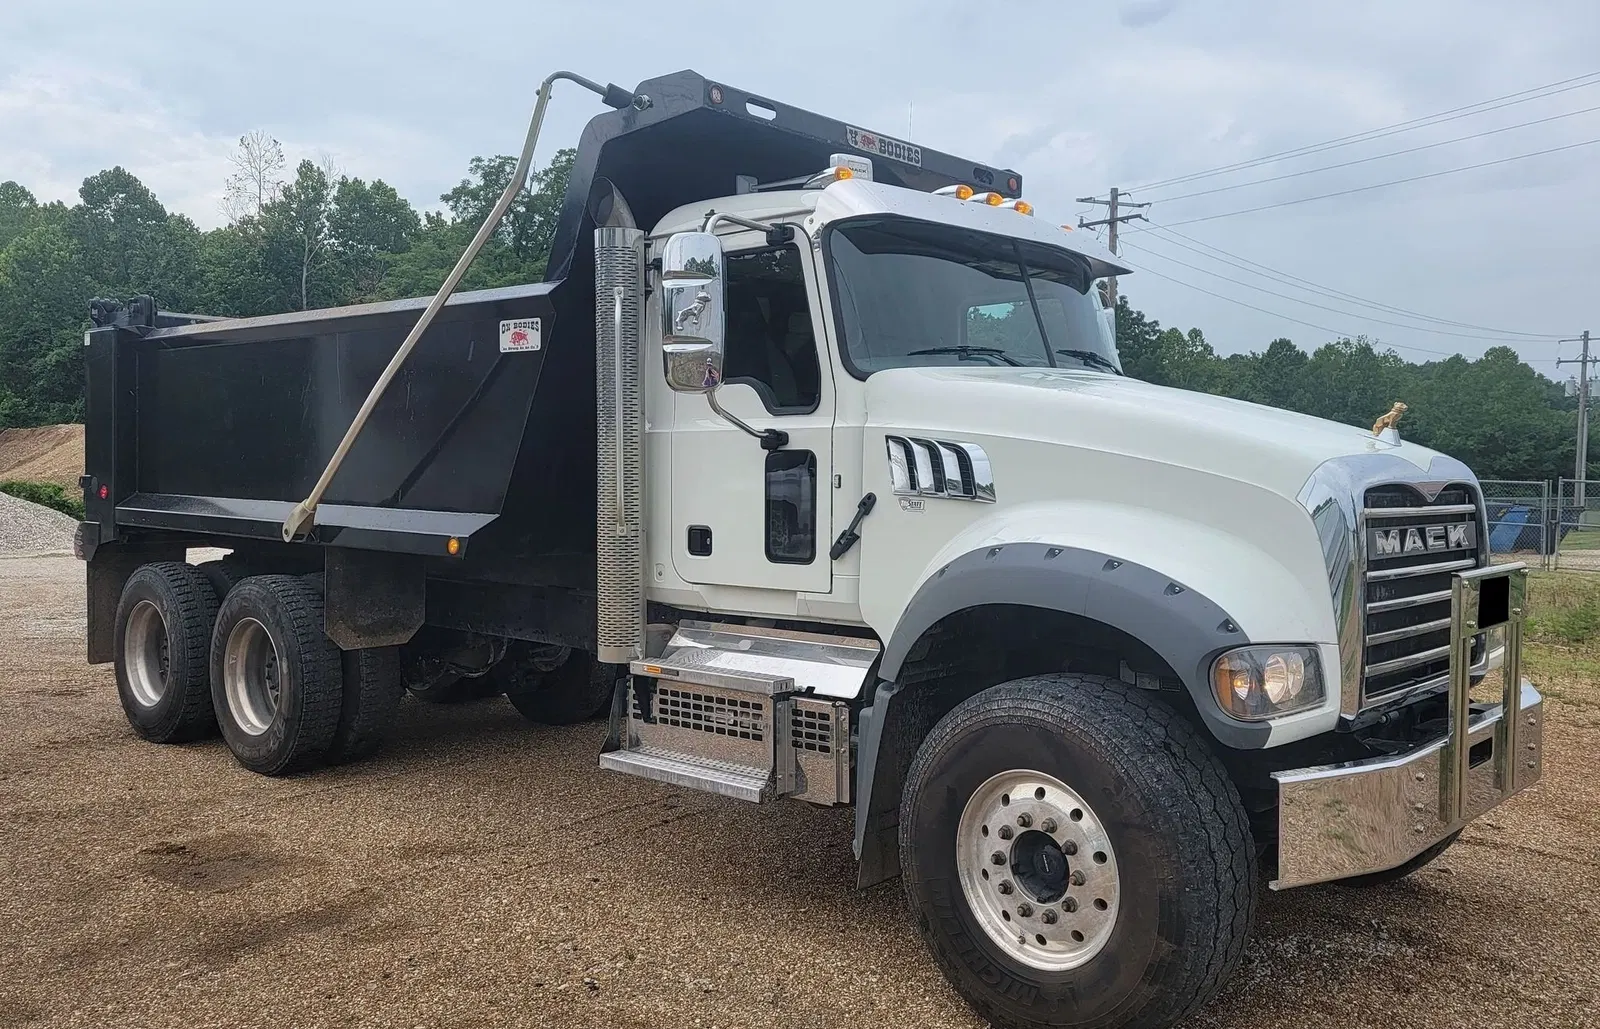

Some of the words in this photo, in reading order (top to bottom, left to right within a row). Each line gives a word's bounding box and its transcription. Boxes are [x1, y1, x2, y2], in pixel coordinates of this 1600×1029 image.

[878, 138, 920, 165] BODIES
[513, 321, 539, 332] BODIES
[1375, 524, 1469, 555] MACK
